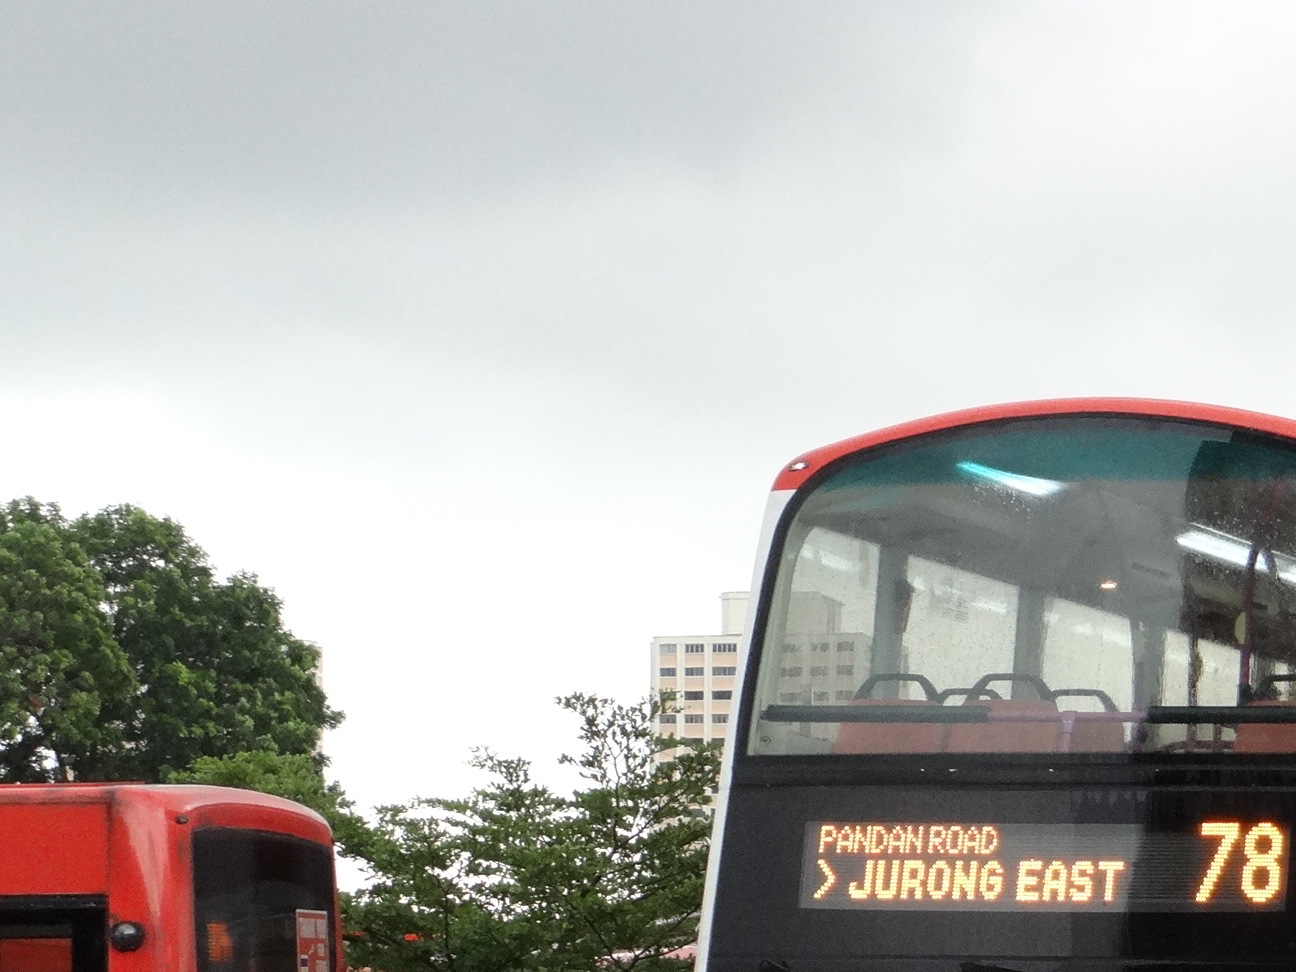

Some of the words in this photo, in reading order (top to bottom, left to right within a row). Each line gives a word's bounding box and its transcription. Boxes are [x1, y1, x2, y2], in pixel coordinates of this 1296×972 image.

[818, 824, 923, 854] PANDAN
[927, 825, 998, 854] ROAD
[848, 858, 1005, 901] JURONG
[1015, 858, 1127, 902] EAST
[1195, 820, 1286, 903] 78
